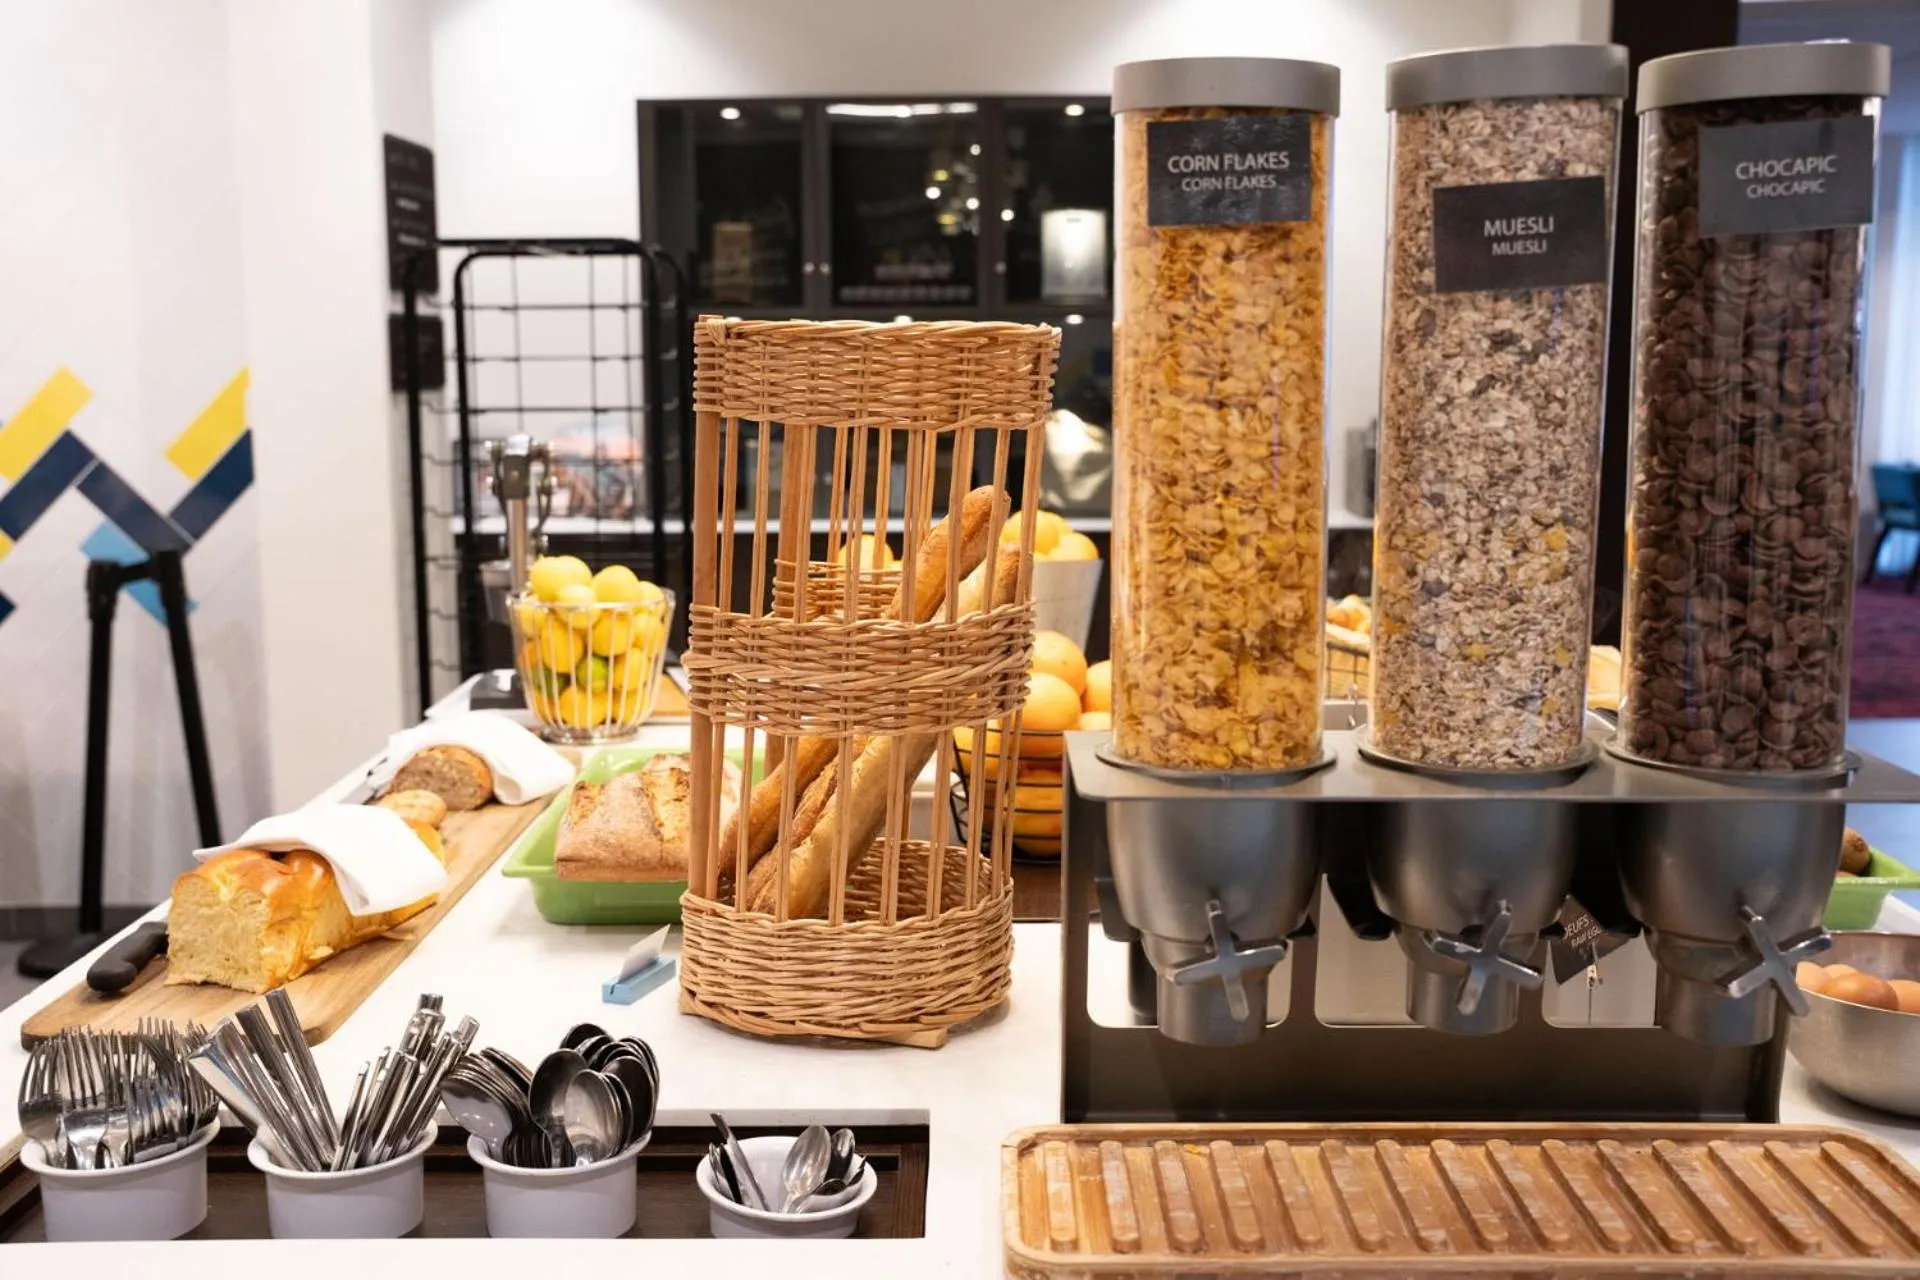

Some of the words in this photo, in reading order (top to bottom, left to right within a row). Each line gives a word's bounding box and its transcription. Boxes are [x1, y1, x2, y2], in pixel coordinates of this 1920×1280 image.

[1167, 154, 1220, 173] CORN
[1224, 151, 1290, 171] FLAKES
[1735, 154, 1838, 181] CHOCAPIC
[1181, 176, 1222, 192] CORN
[1224, 174, 1277, 190] FLAKES
[1746, 178, 1827, 199] CHOCAPIC
[1483, 216, 1554, 237] MUESLI
[1491, 239, 1548, 256] MUESLI
